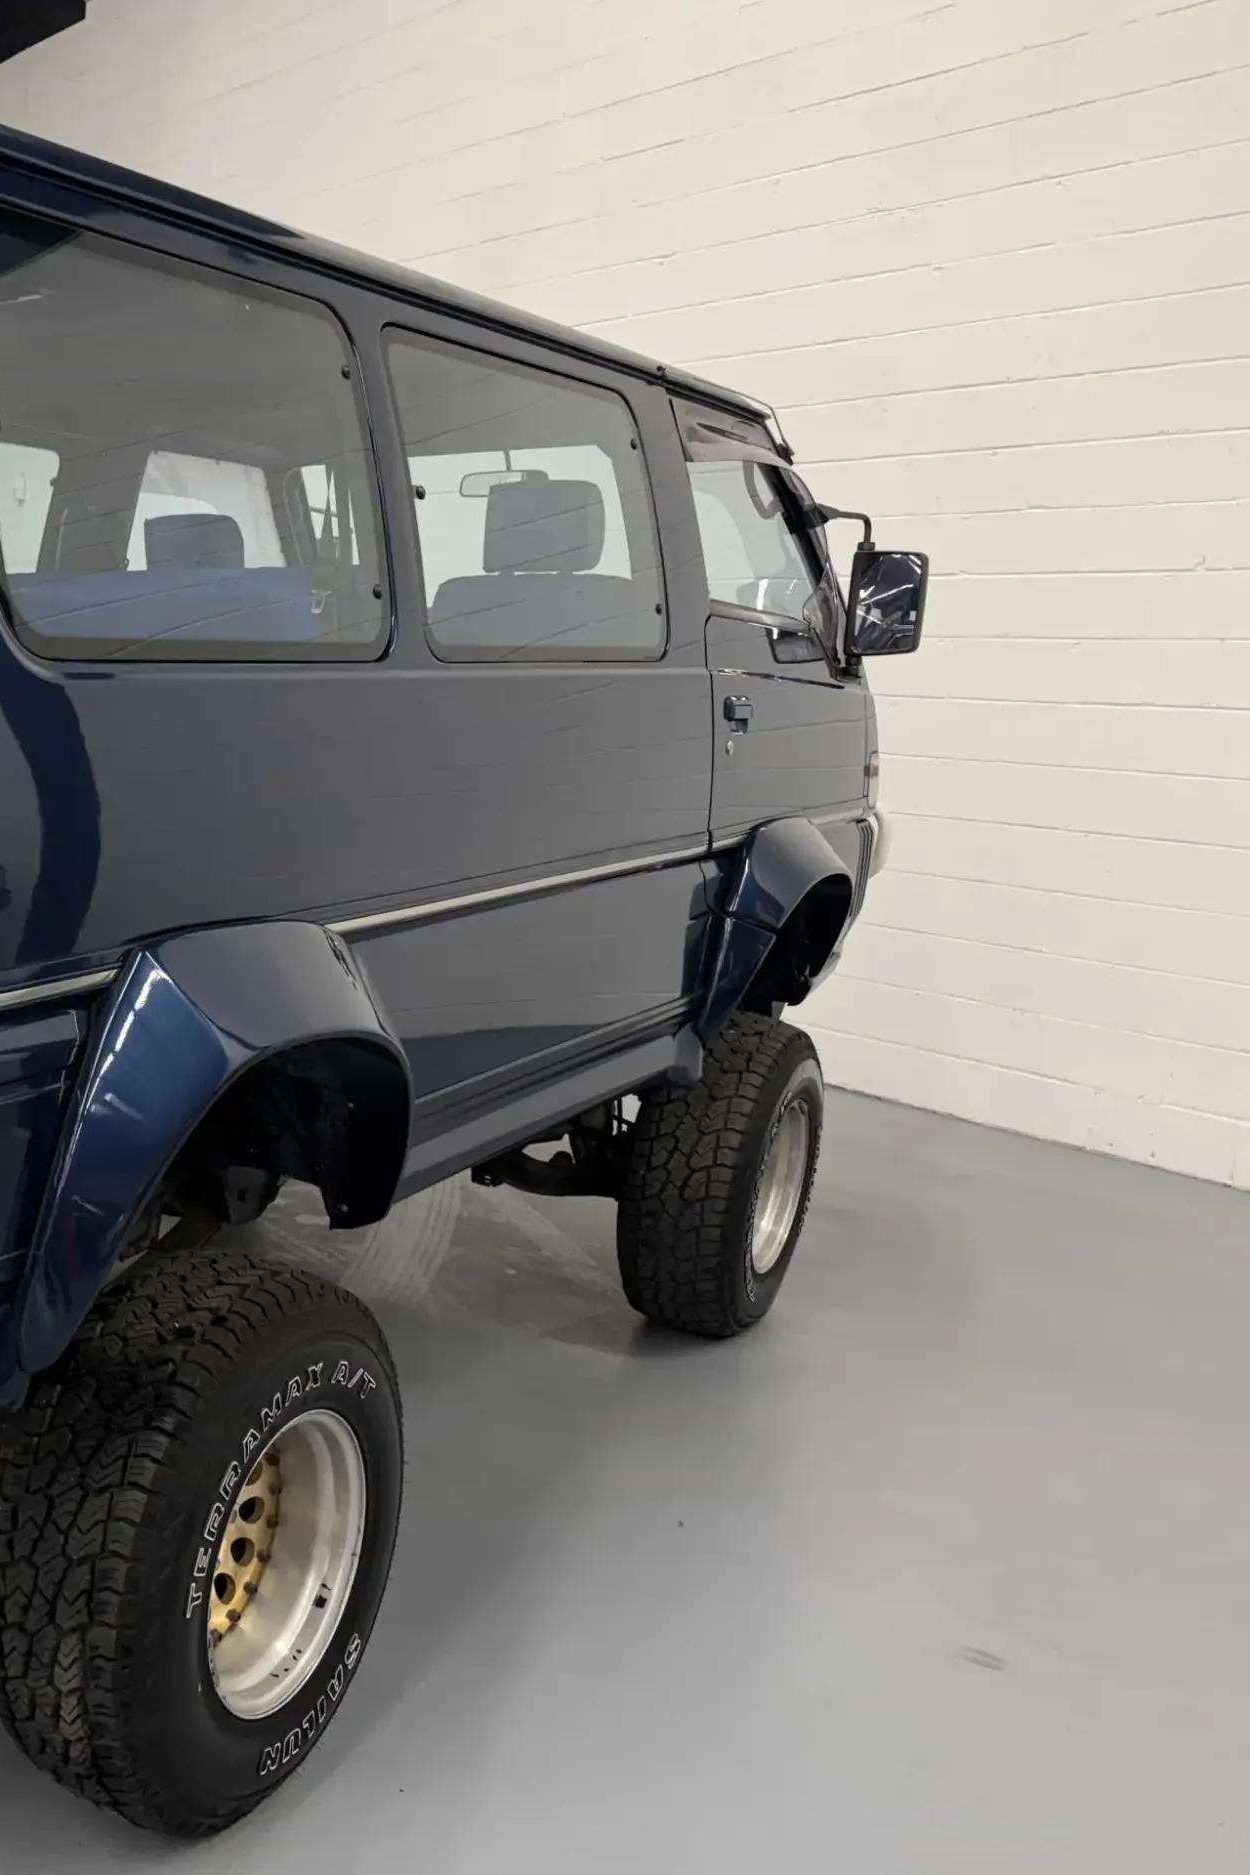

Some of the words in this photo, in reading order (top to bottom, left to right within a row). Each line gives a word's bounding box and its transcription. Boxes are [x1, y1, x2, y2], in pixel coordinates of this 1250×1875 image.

[186, 1363, 324, 1619] TERRAMAX
[331, 1360, 376, 1399] A/T
[260, 1633, 362, 1776] SAILUN
